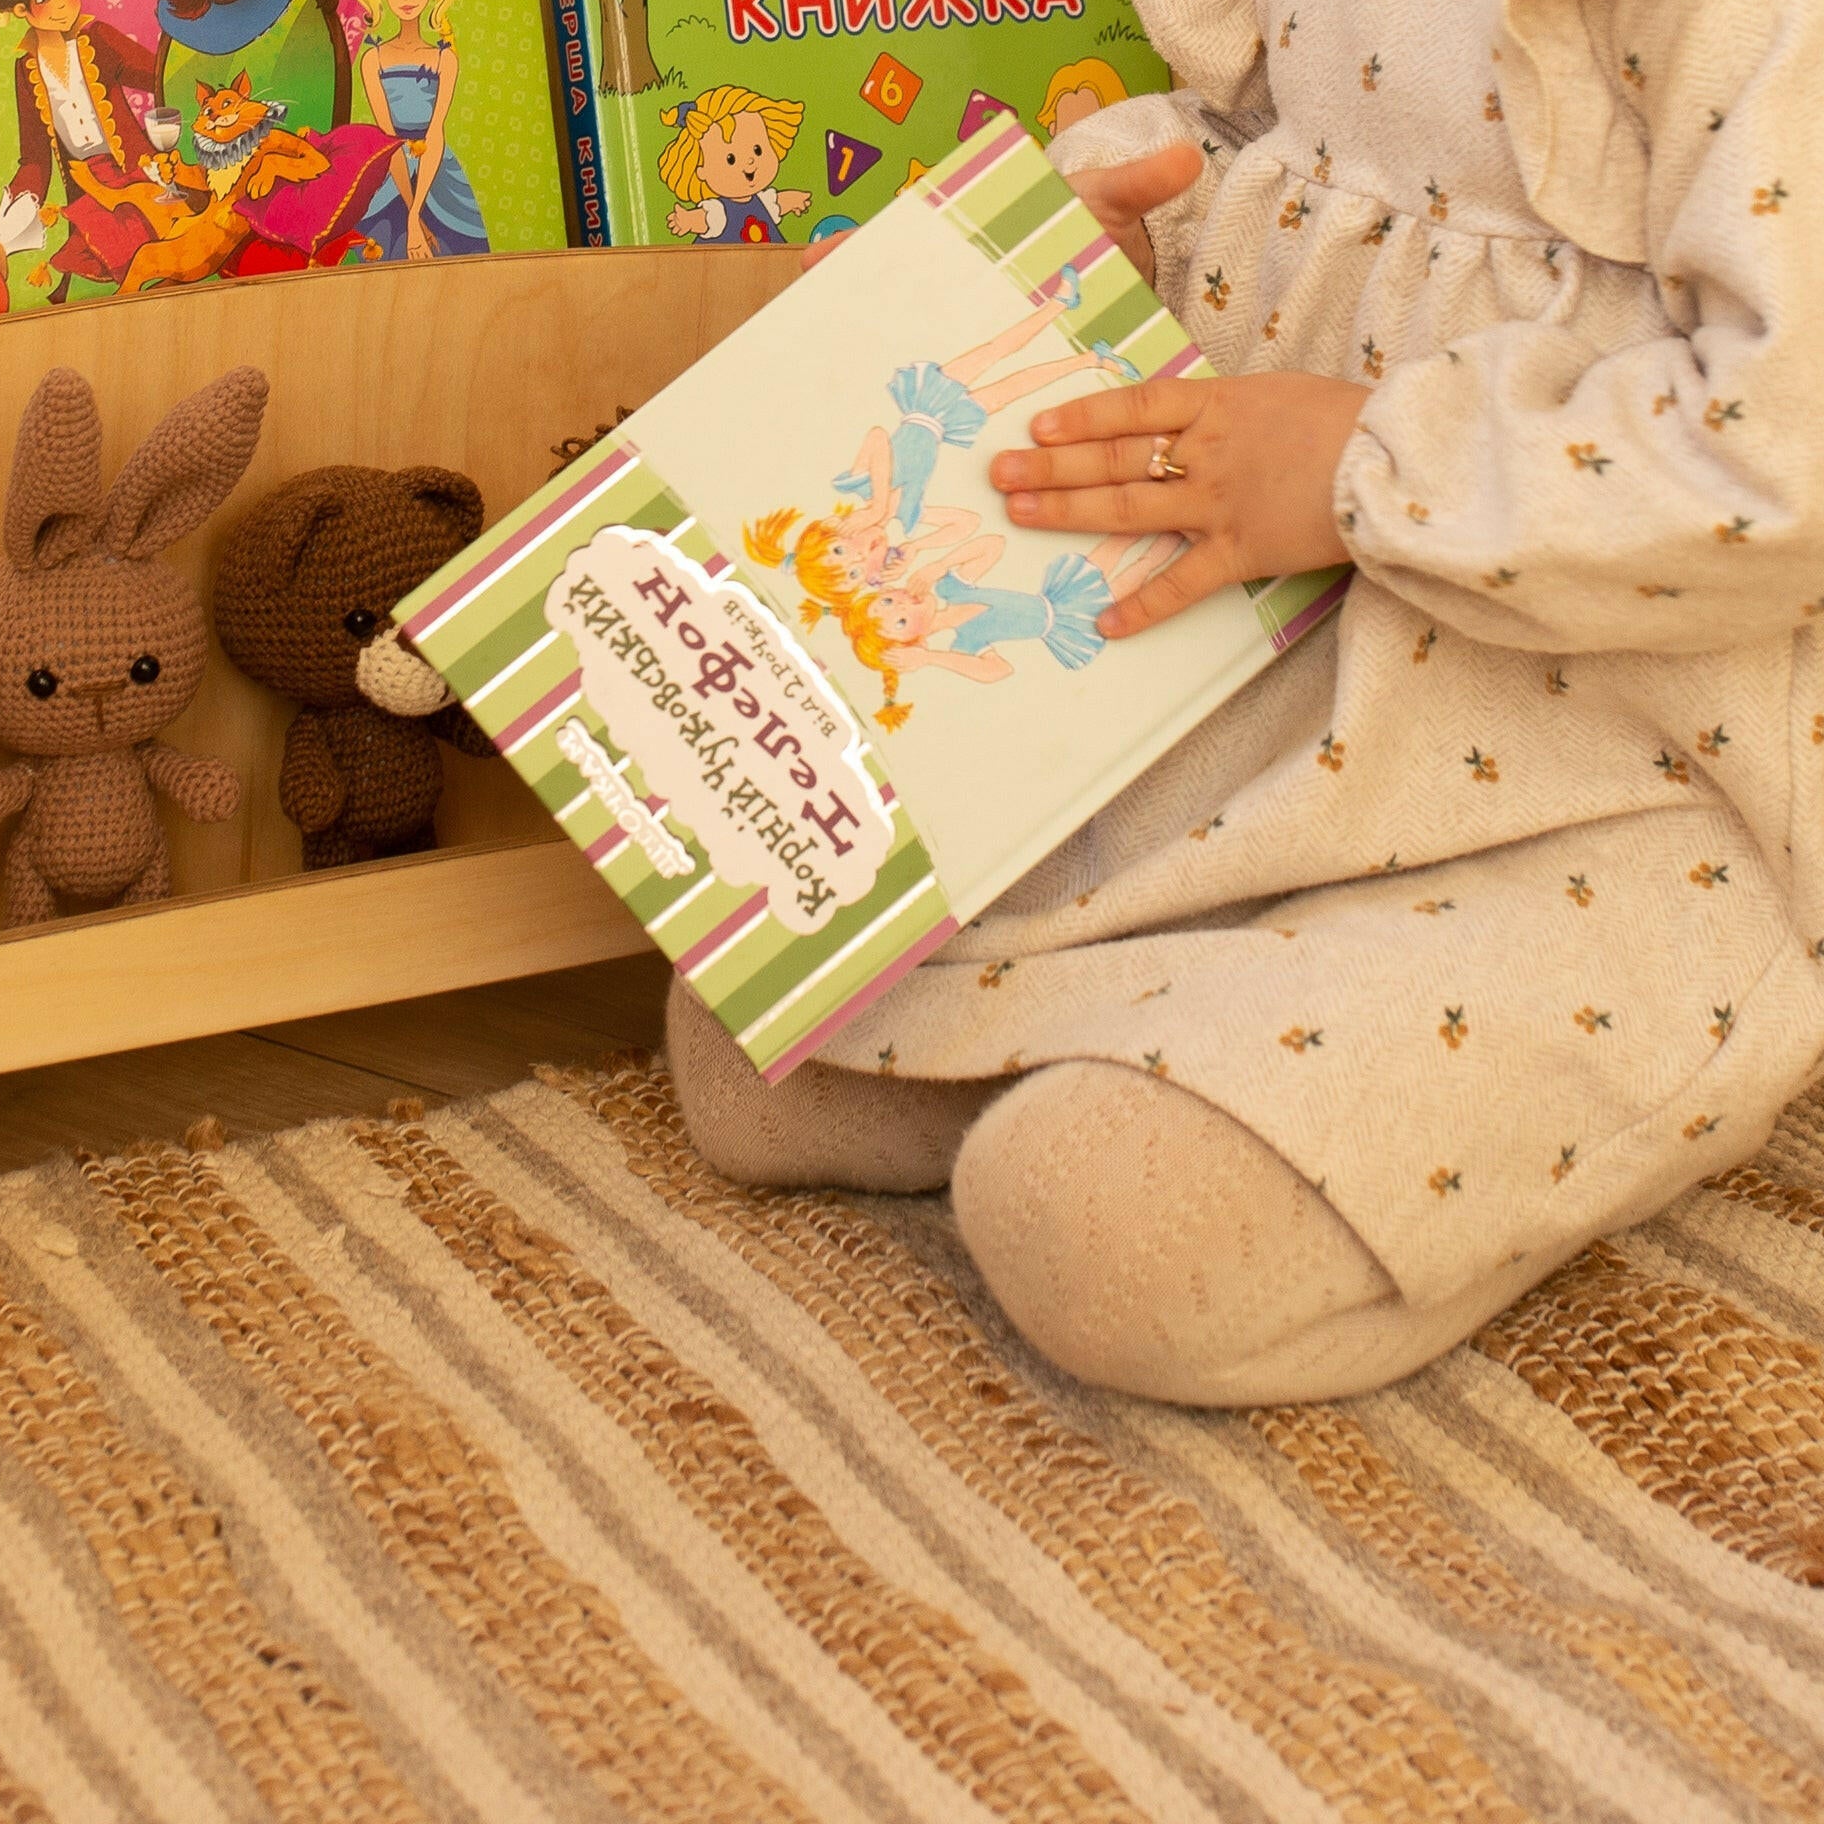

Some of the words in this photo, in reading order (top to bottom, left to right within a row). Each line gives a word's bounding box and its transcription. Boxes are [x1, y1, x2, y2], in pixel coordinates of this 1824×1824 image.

[880, 68, 904, 108] 6
[837, 146, 854, 182] 1
[783, 674, 804, 700] 2
